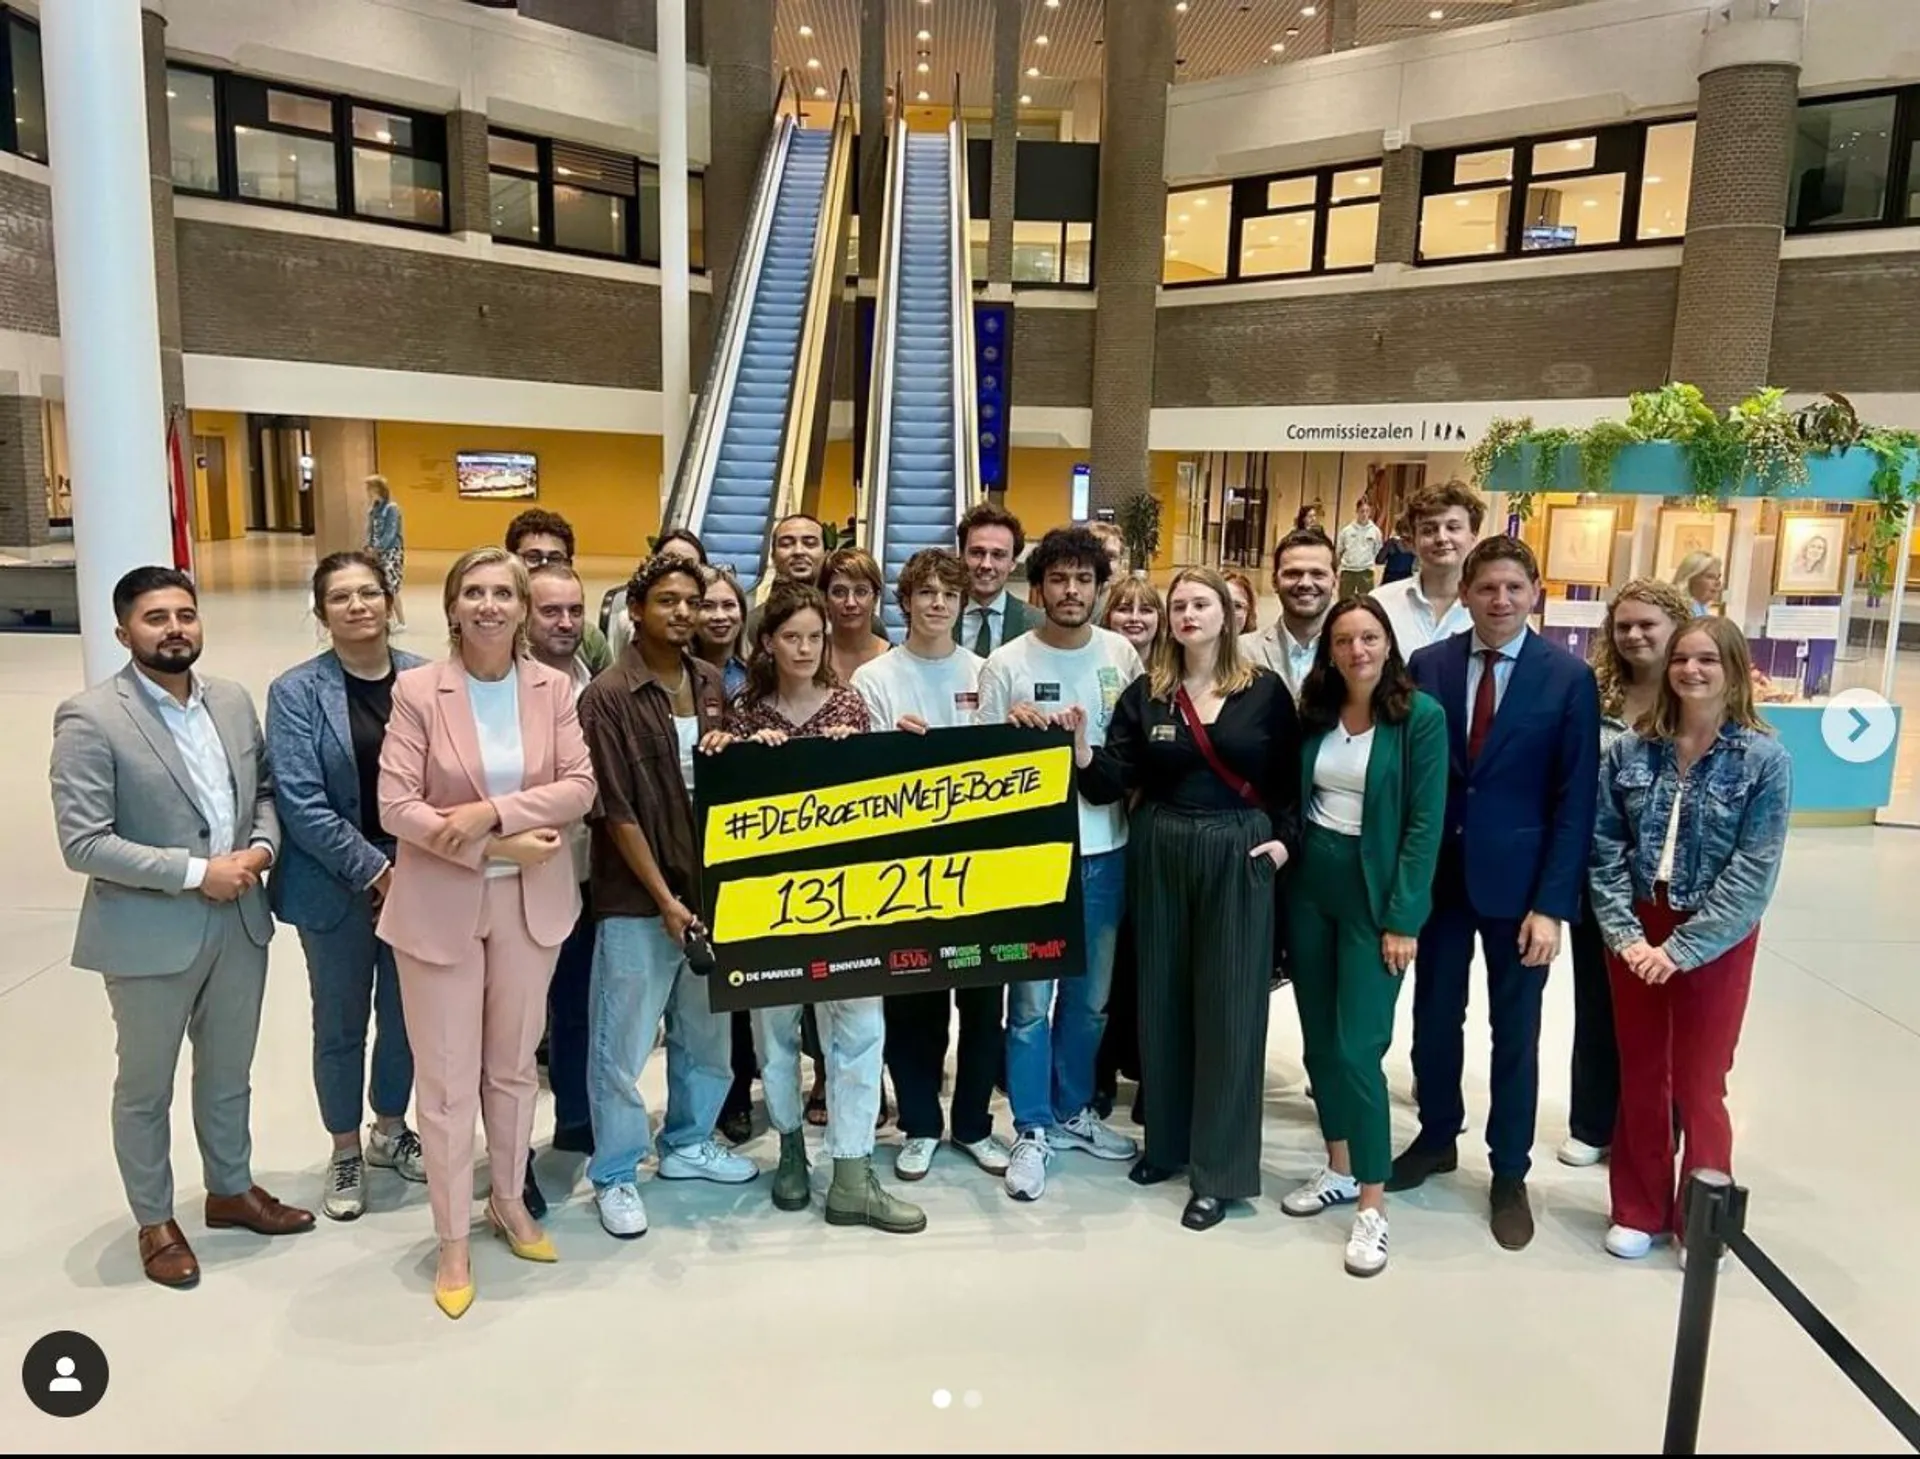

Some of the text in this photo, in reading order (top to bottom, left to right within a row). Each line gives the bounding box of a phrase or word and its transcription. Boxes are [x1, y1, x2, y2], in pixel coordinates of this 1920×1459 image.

[1287, 422, 1413, 440] Commissiezalen
[770, 856, 972, 930] 131.214
[746, 968, 804, 982] DE MARKER
